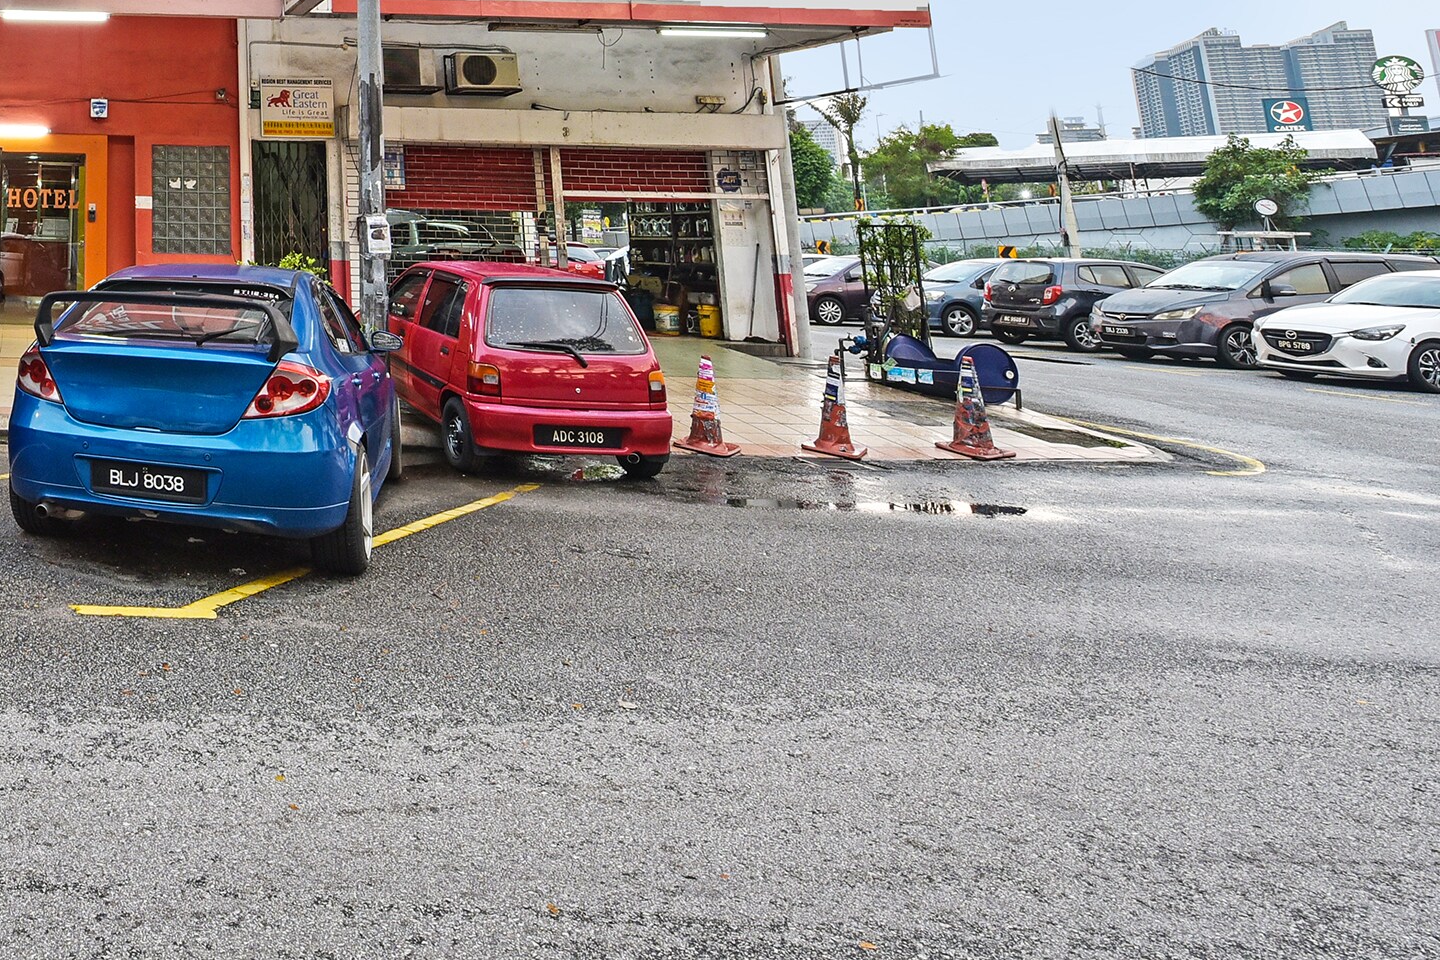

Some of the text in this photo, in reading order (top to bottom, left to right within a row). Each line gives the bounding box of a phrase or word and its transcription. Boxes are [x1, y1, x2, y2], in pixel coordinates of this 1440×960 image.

[292, 89, 319, 100] Great
[293, 99, 328, 109] Eastern
[6, 188, 80, 209] HOTEL
[552, 430, 604, 444] ADC 3108
[109, 468, 185, 493] BLJ 8038
